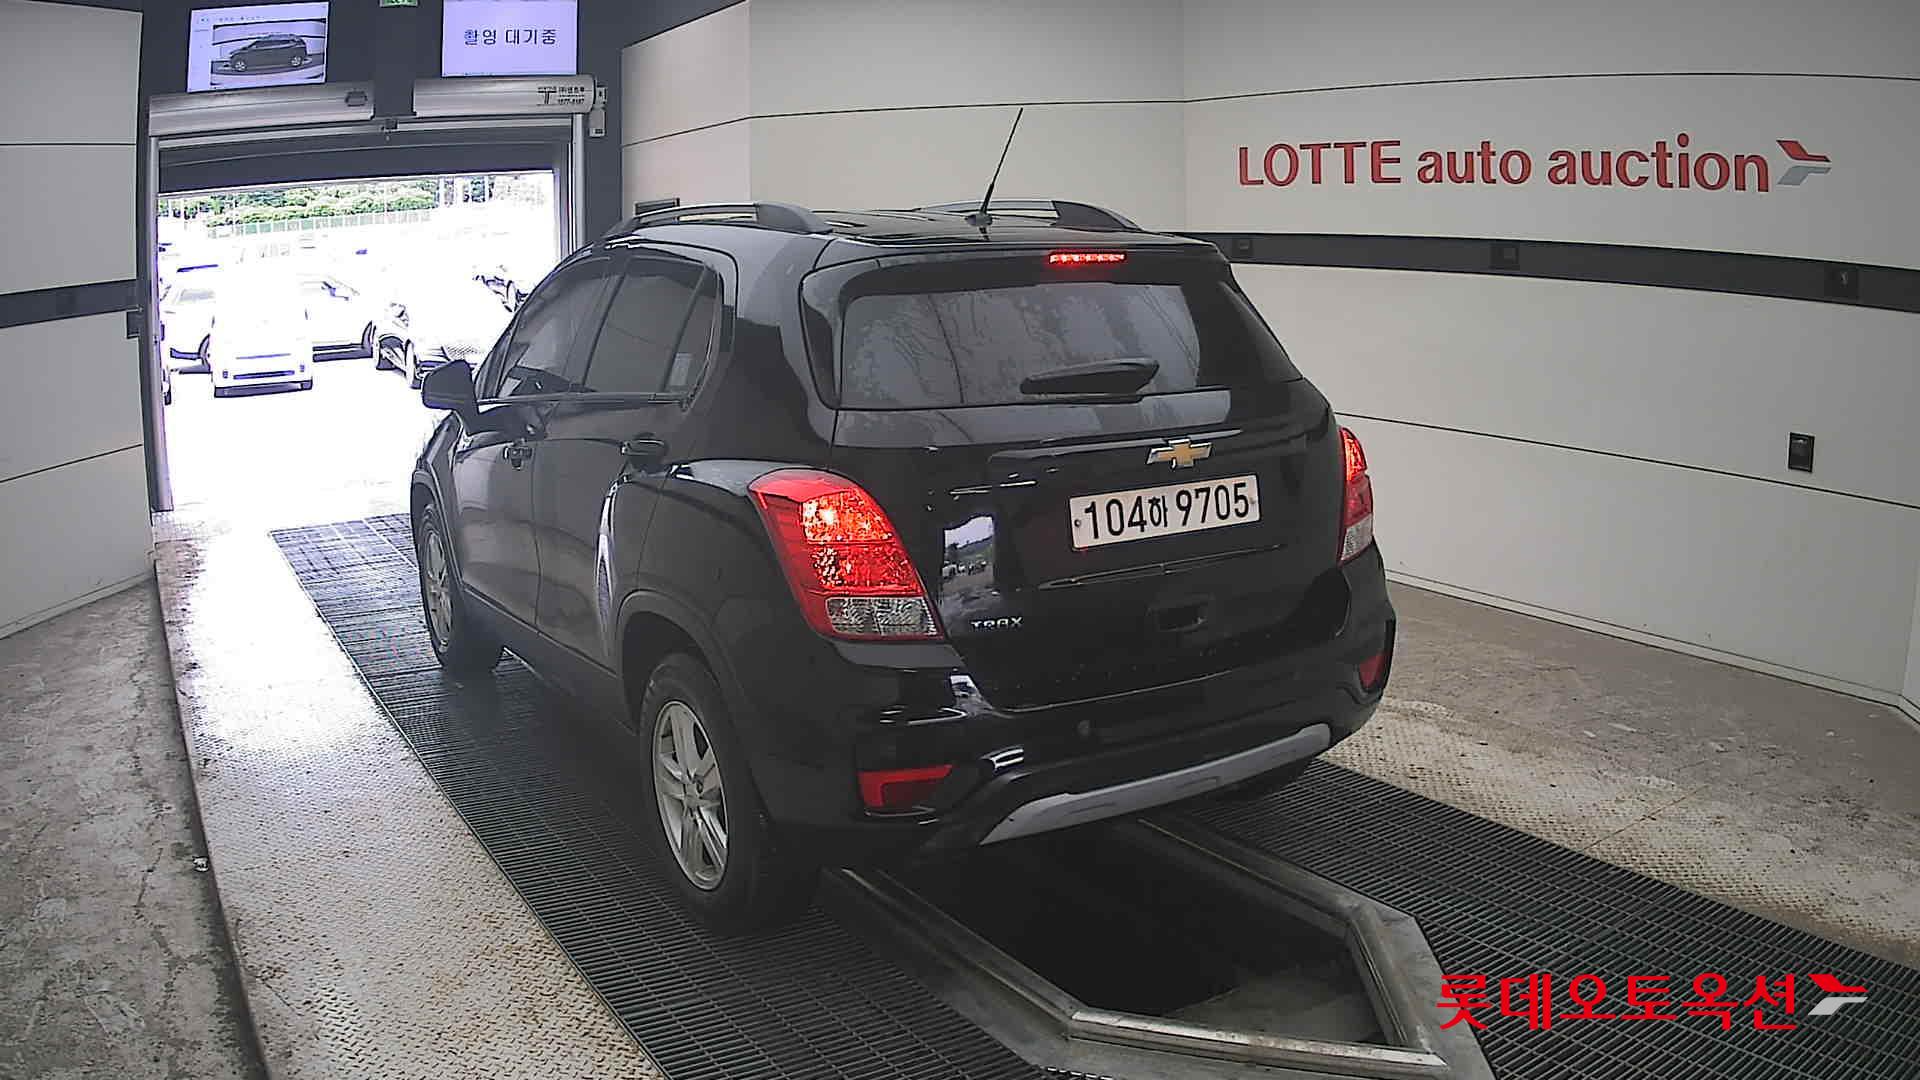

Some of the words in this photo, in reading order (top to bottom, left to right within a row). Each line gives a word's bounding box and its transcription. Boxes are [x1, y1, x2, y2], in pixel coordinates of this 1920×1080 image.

[506, 28, 556, 46] 대기중
[1240, 140, 1401, 186] LOTTE
[1417, 141, 1532, 184] auto
[1547, 134, 1771, 193] auction
[1084, 495, 1169, 540] 104하
[1175, 482, 1251, 527] 9705
[970, 616, 1022, 630] TRAX
